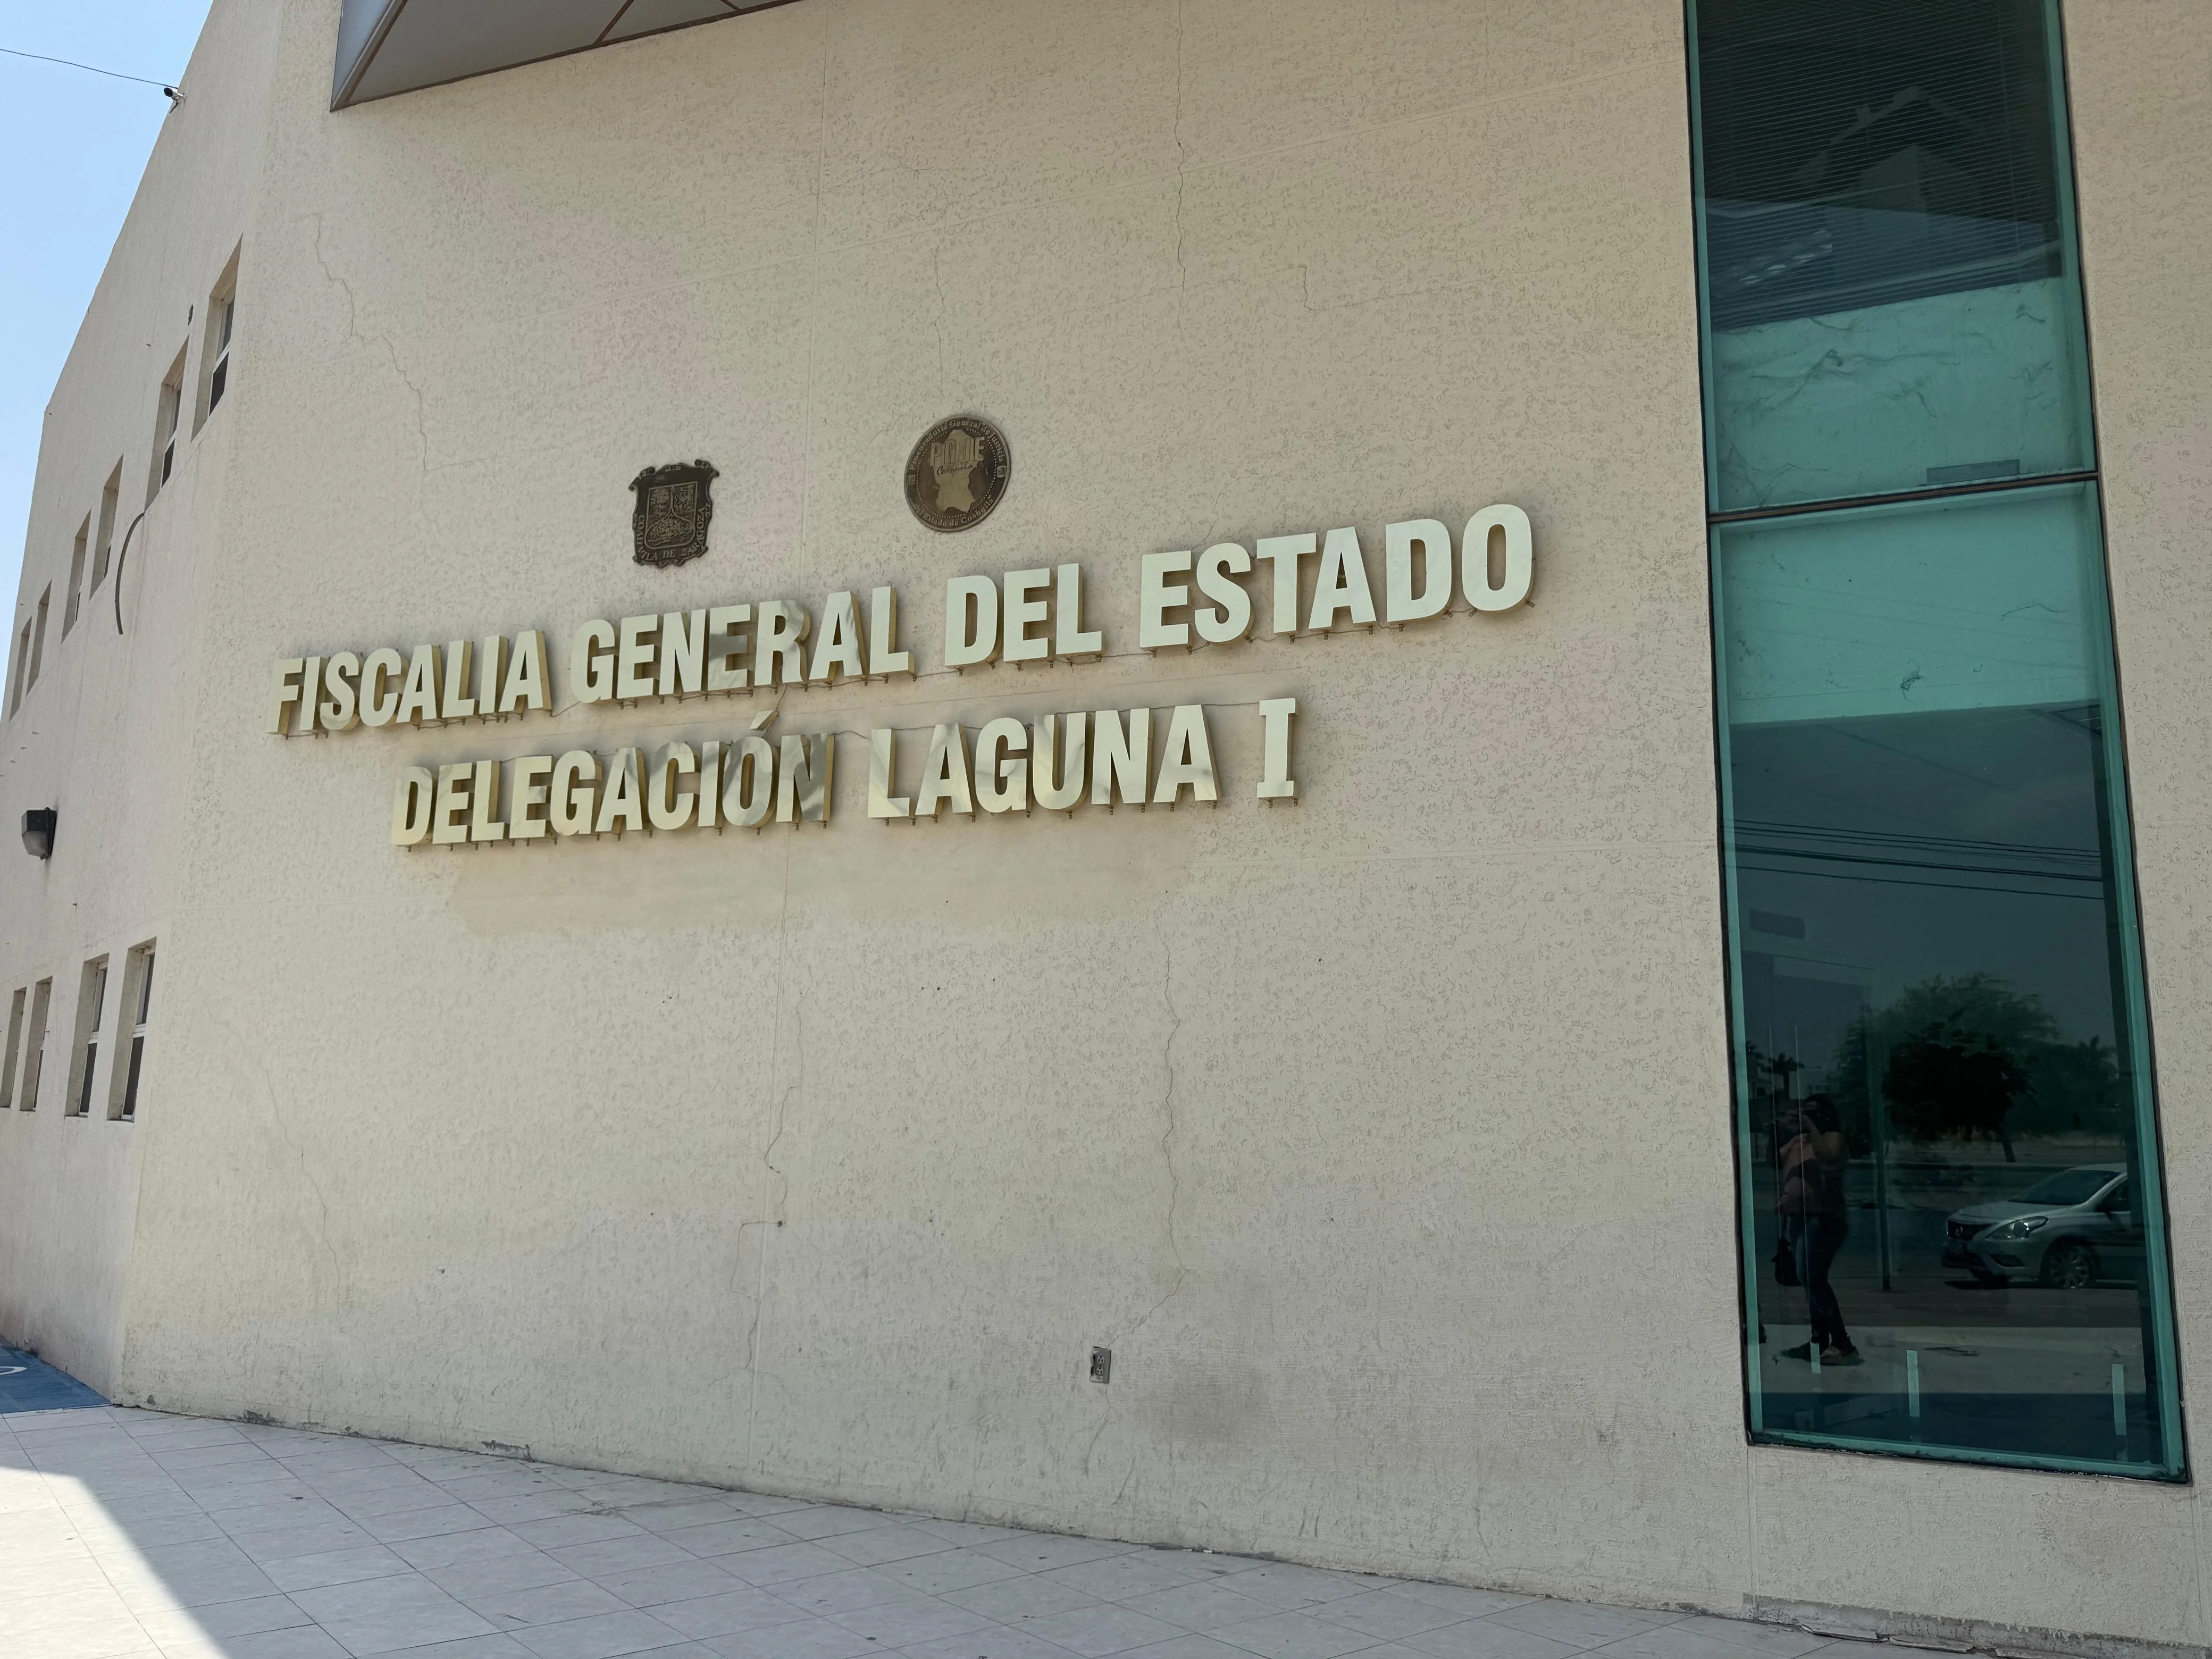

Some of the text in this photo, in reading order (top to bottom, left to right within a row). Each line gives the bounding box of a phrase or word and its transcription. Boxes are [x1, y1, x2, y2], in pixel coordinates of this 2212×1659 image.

[950, 419, 980, 429] General
[981, 423, 990, 435] de
[987, 431, 1005, 463] Justicia
[663, 549, 676, 558] DE
[681, 507, 706, 557] ZARAGOZA
[923, 512, 947, 527] Estado
[961, 498, 994, 524] Coahuila
[266, 504, 1535, 735] FISCALIA GENERAL DEL ESTADO
[391, 698, 1298, 847] DELEGACIÓN LAGUNA I
